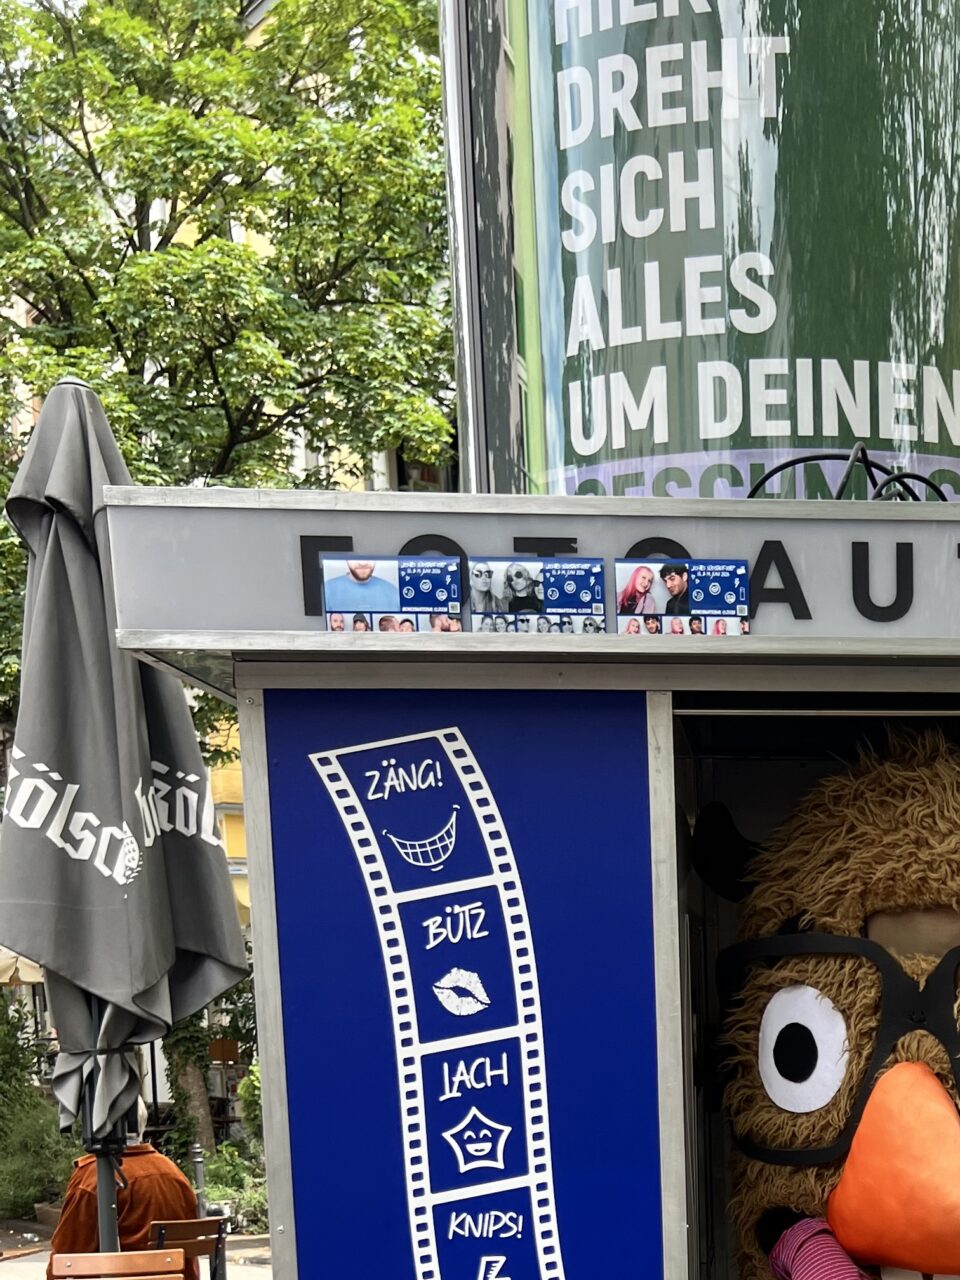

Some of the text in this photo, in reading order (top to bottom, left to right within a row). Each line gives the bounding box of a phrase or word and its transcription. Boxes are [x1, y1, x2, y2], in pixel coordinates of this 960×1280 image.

[556, 36, 790, 150] DREHT
[561, 149, 716, 254] SICH
[566, 251, 777, 357] ALLES
[569, 366, 669, 456] UM
[365, 758, 443, 801] ZÄNG!
[422, 901, 489, 950] BÜTZ
[439, 1052, 509, 1101] LACH
[448, 1211, 523, 1239] KNIPS!
